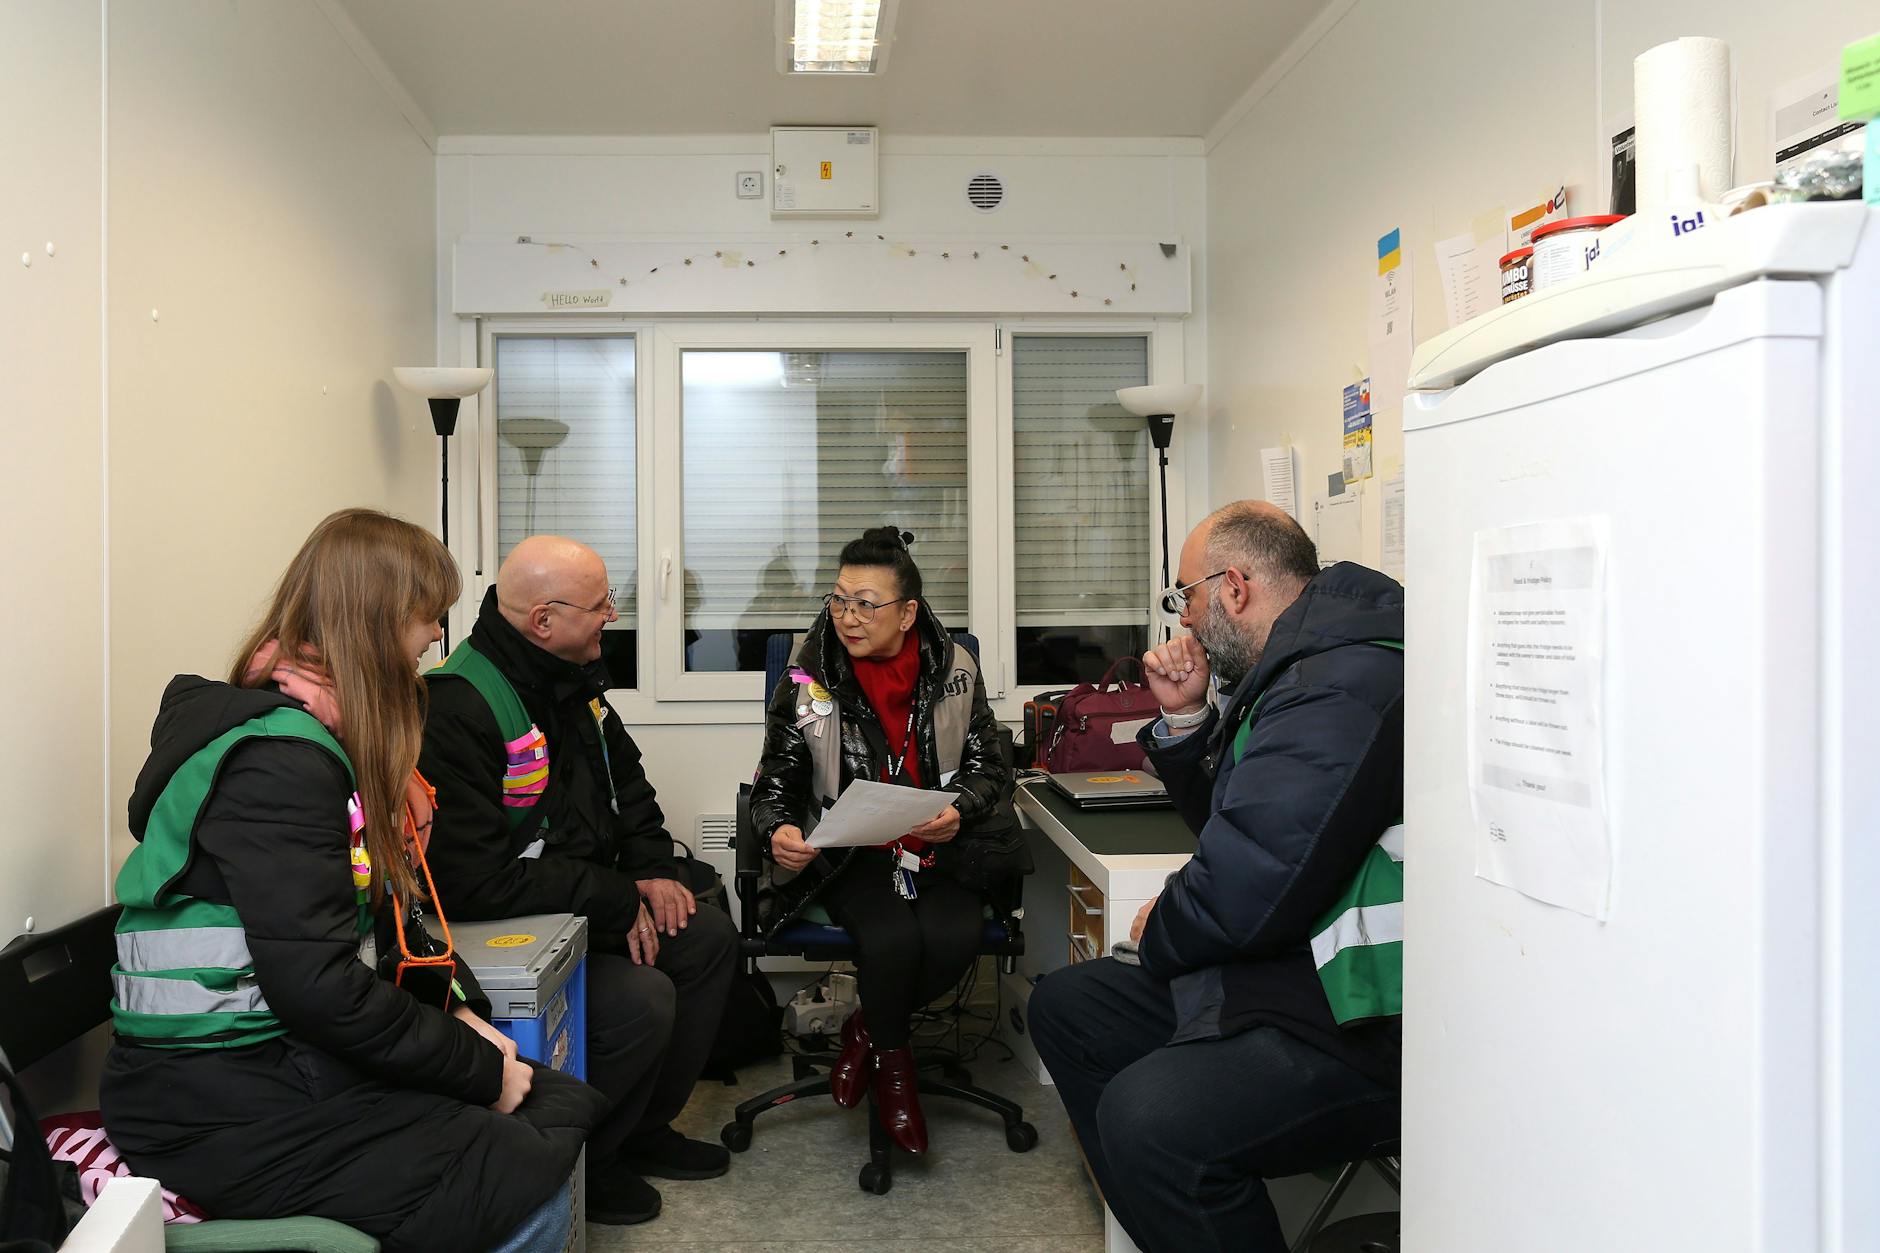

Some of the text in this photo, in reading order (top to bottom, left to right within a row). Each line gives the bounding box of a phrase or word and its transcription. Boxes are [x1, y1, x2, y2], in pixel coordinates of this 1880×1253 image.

[1671, 211, 1705, 237] ja!
[1585, 238, 1601, 272] ja!
[1502, 265, 1528, 286] UMBO
[551, 293, 579, 307] HELLO
